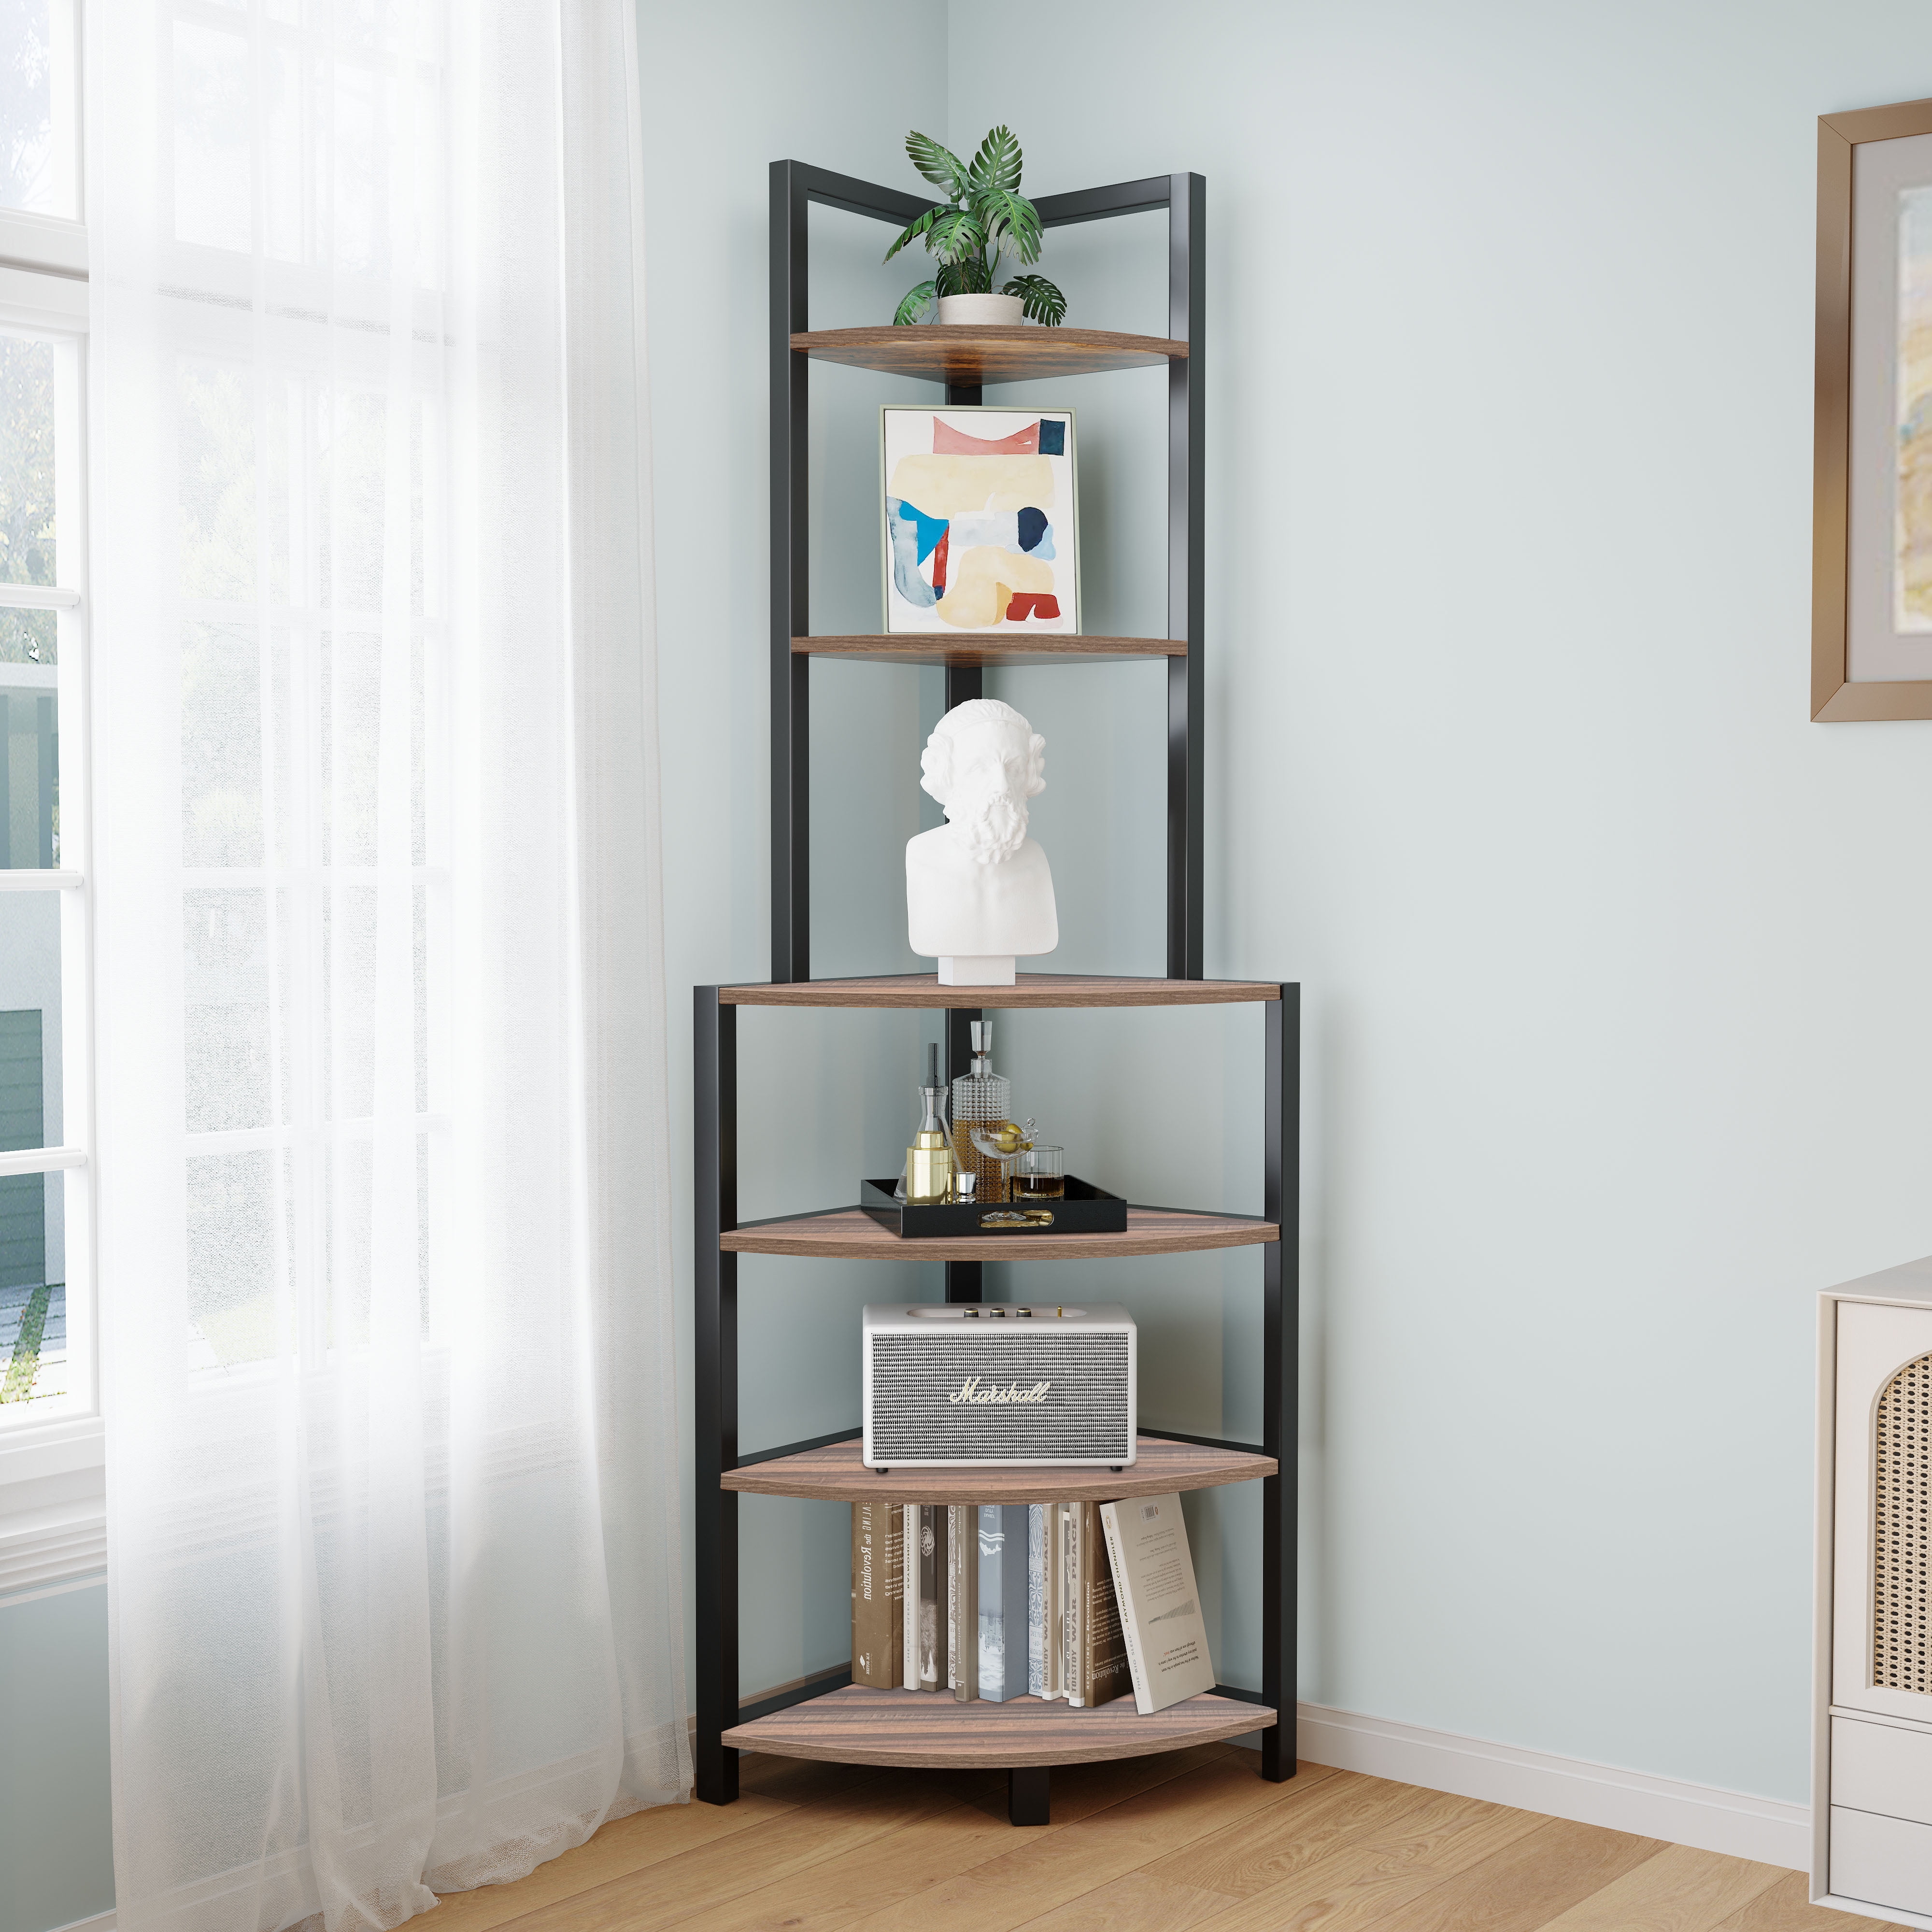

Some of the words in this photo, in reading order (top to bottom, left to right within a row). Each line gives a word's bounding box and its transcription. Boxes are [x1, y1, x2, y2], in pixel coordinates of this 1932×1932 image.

[949, 1376, 1051, 1404] Marshall
[1109, 1536, 1121, 1578] CHANDLER
[1118, 1581, 1129, 1622] RAYMOND
[1092, 1664, 1119, 1680] Revolution
